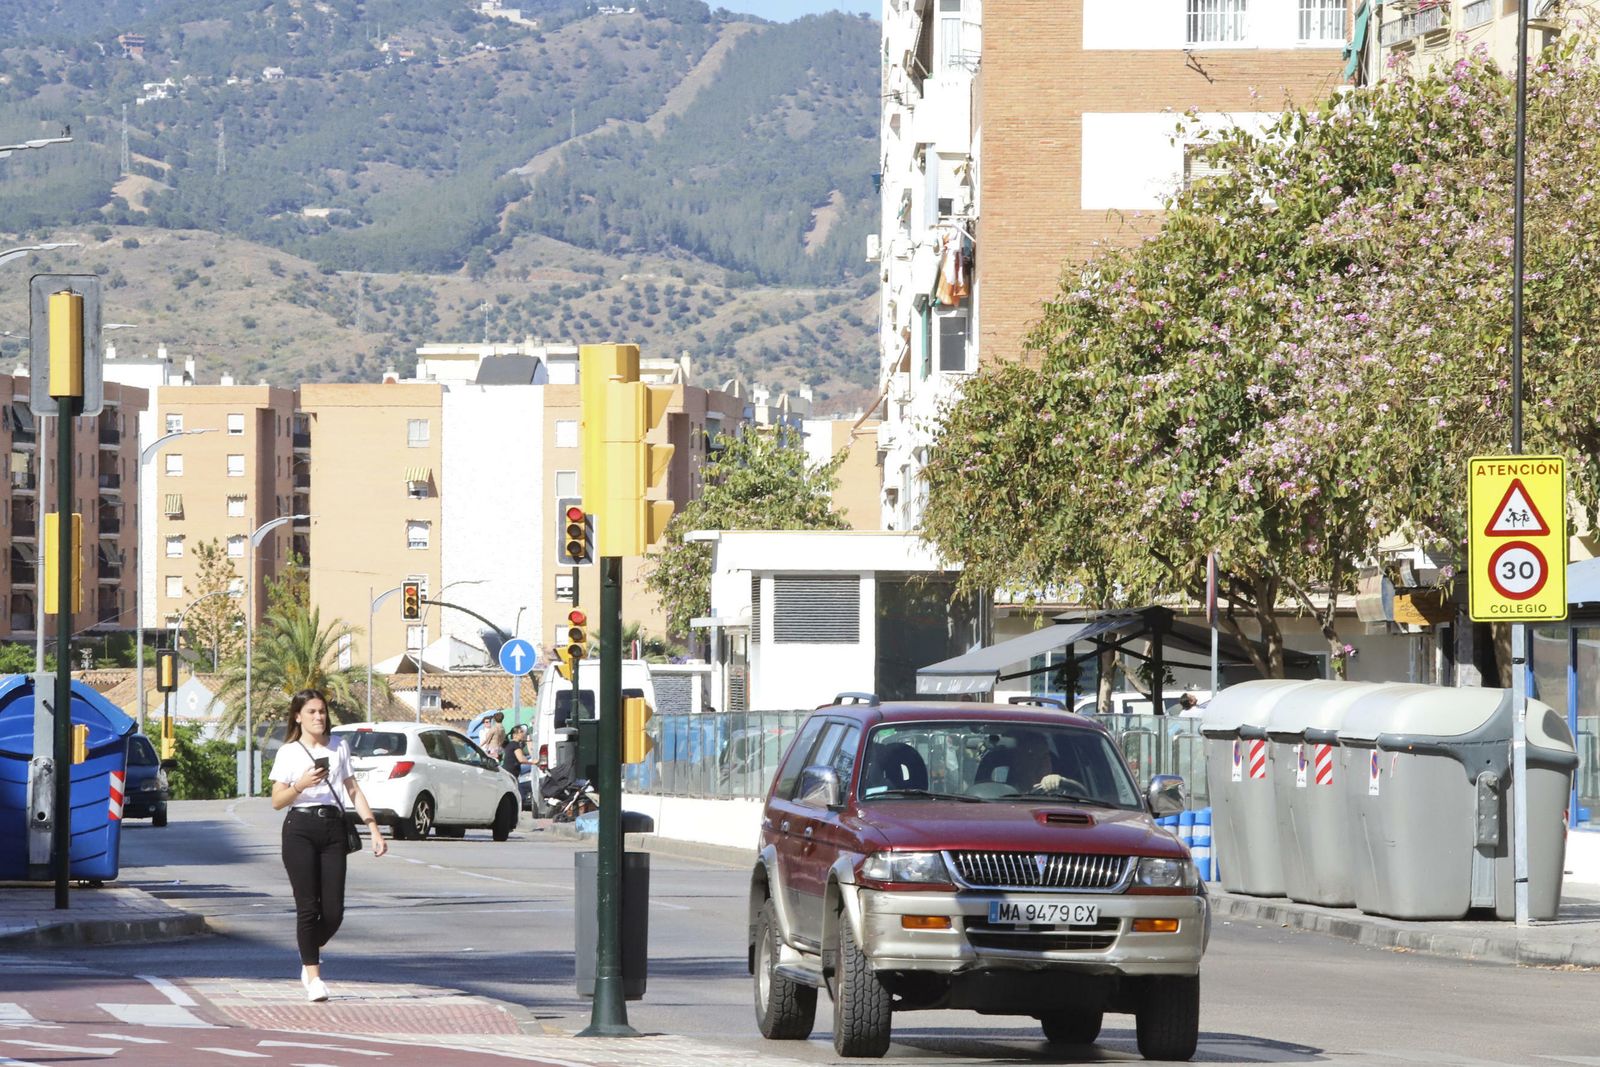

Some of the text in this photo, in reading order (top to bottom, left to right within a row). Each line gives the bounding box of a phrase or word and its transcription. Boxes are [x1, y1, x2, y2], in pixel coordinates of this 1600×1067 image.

[1476, 461, 1559, 476] ATENCIÓN
[1502, 561, 1534, 580] 30
[1490, 604, 1547, 613] COLEGIO
[999, 903, 1096, 923] MA 9479 CX
